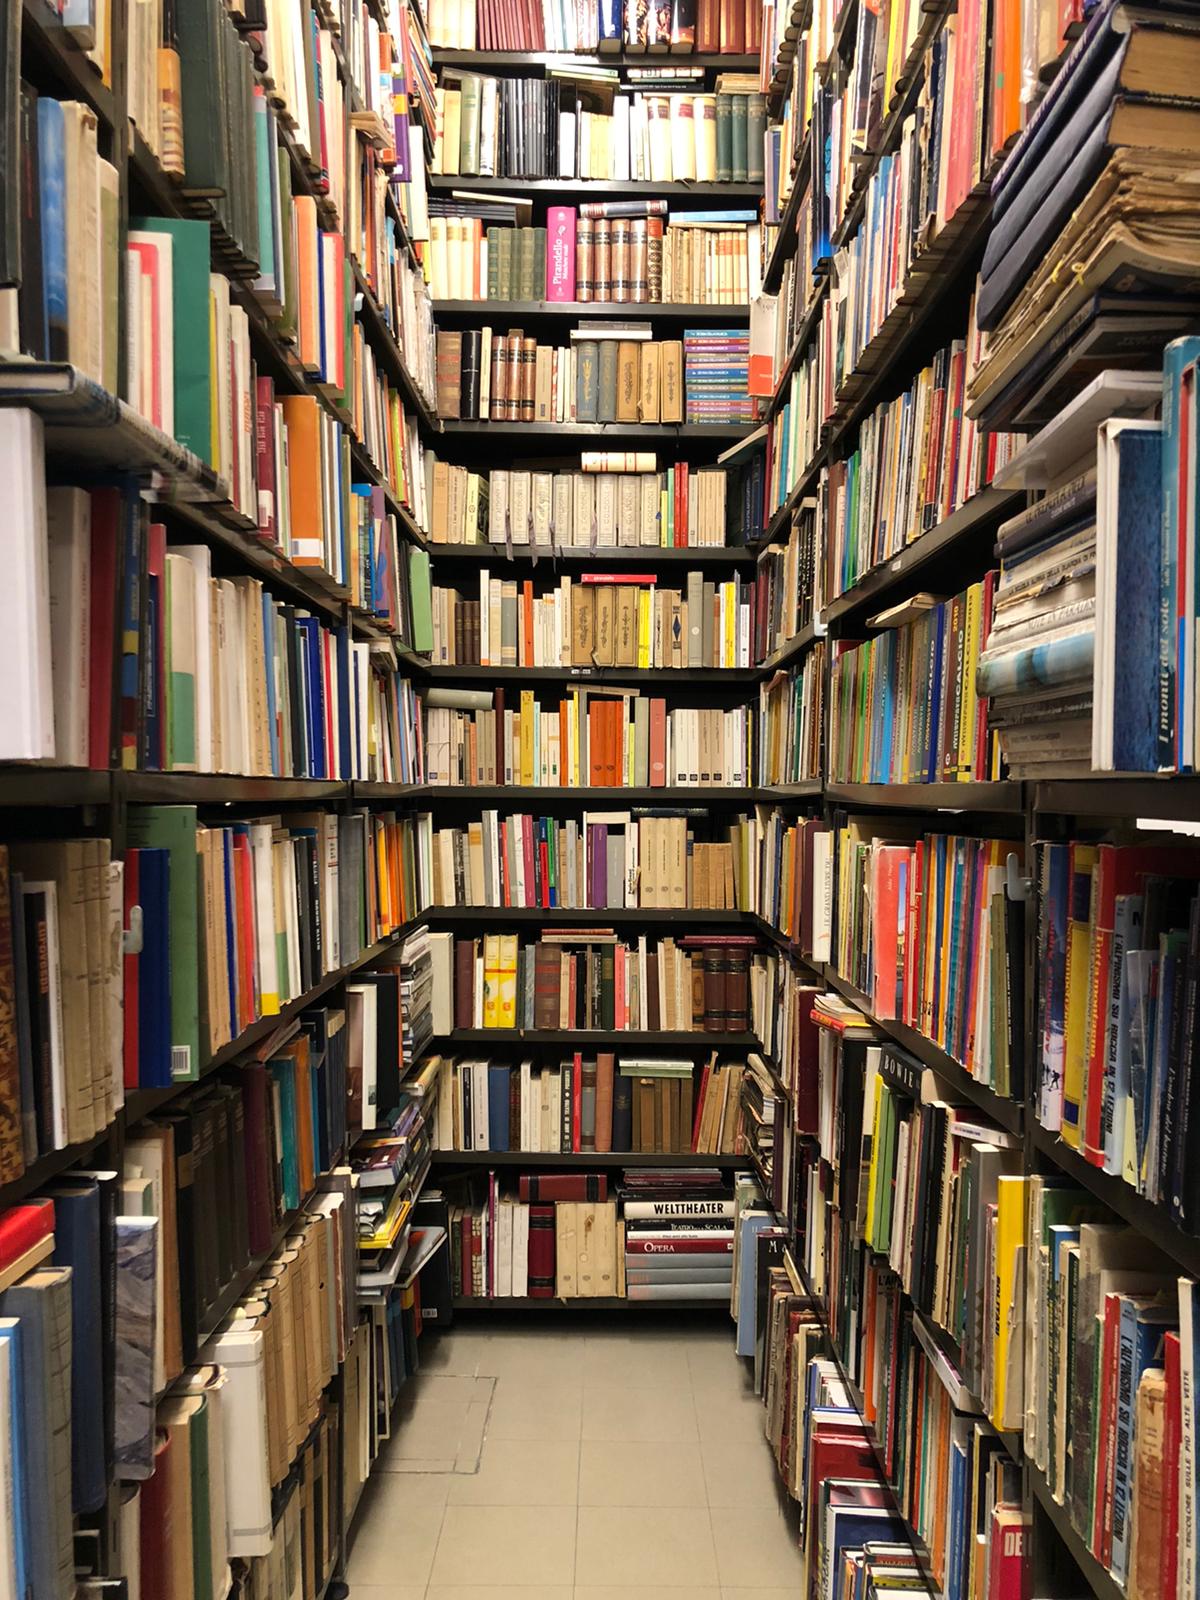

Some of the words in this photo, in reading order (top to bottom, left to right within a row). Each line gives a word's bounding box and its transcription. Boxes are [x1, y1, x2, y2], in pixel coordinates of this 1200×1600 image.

[552, 239, 562, 284] Pirandello
[1160, 597, 1170, 634] sole
[954, 629, 964, 696] CALCIO
[963, 623, 973, 691] CALCIO
[1159, 639, 1169, 667] del
[1159, 671, 1169, 731] monti
[1111, 933, 1124, 1003] L'ALPINISMO
[1090, 971, 1101, 1058] montagna
[1110, 1004, 1120, 1020] SU
[1107, 1022, 1118, 1061] ROCCIA
[883, 1053, 915, 1091] BOWIE
[1105, 1080, 1115, 1093] 12
[1106, 1065, 1116, 1078] IN
[1103, 1095, 1115, 1134] LEZIONI
[654, 1203, 723, 1214] WELTTHEATER
[671, 1223, 694, 1231] TEATRO
[705, 1223, 728, 1231] SCALA
[644, 1241, 675, 1252] OPERA
[1120, 1334, 1135, 1402] L'ALPINISMO
[1119, 1406, 1131, 1423] SU
[1116, 1426, 1130, 1464] ROCCIA
[1113, 1482, 1124, 1495] 12
[1115, 1466, 1126, 1479] IN
[1110, 1497, 1123, 1542] LEZIONI
